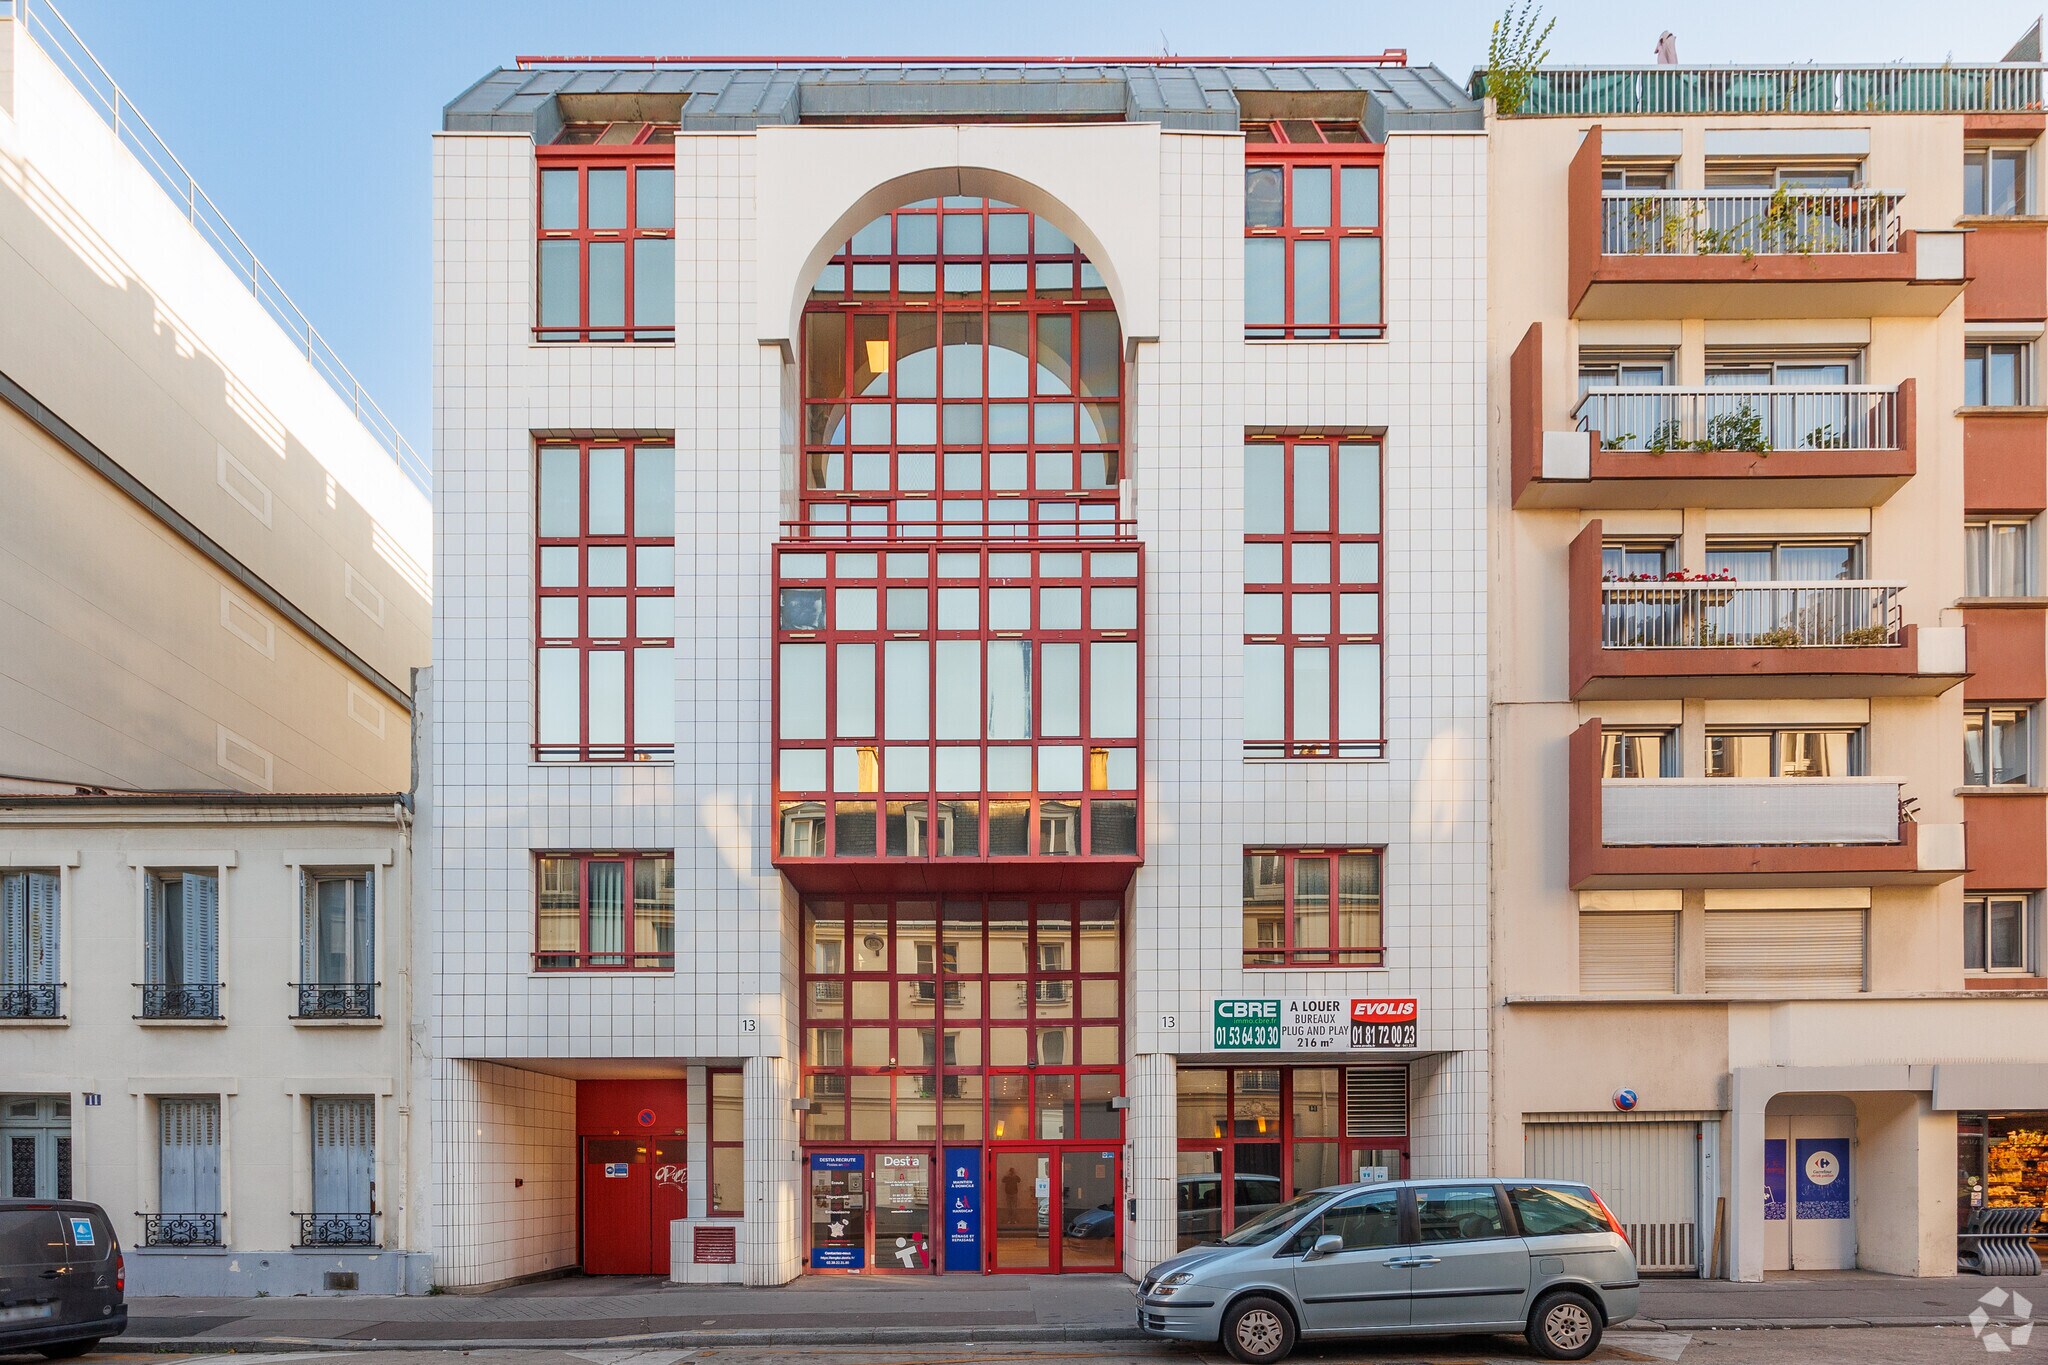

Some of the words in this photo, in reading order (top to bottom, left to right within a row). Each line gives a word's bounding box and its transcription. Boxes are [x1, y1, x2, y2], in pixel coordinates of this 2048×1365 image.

[1218, 1002, 1277, 1017] CBRE
[1290, 1001, 1298, 1012] A
[1303, 1001, 1340, 1012] LOUER
[1354, 1003, 1414, 1015] EVOLIS
[1161, 1015, 1176, 1028] 13
[1295, 1014, 1336, 1024] BUREAUX
[742, 1019, 756, 1032] 13
[1281, 1026, 1304, 1036] PLUG
[1306, 1026, 1326, 1036] AND
[1328, 1025, 1349, 1036] PLAY
[1216, 1026, 1226, 1045] 01
[1229, 1026, 1240, 1045] 53
[1241, 1026, 1253, 1045] 64
[1254, 1026, 1266, 1045] 30
[1267, 1026, 1279, 1045] 30
[1352, 1025, 1363, 1044] 01
[1365, 1025, 1376, 1044] 81
[1378, 1025, 1390, 1044] 72
[1391, 1025, 1402, 1044] 00
[1404, 1025, 1415, 1044] 23
[1297, 1038, 1317, 1048] 216
[884, 1155, 920, 1166] Destia
